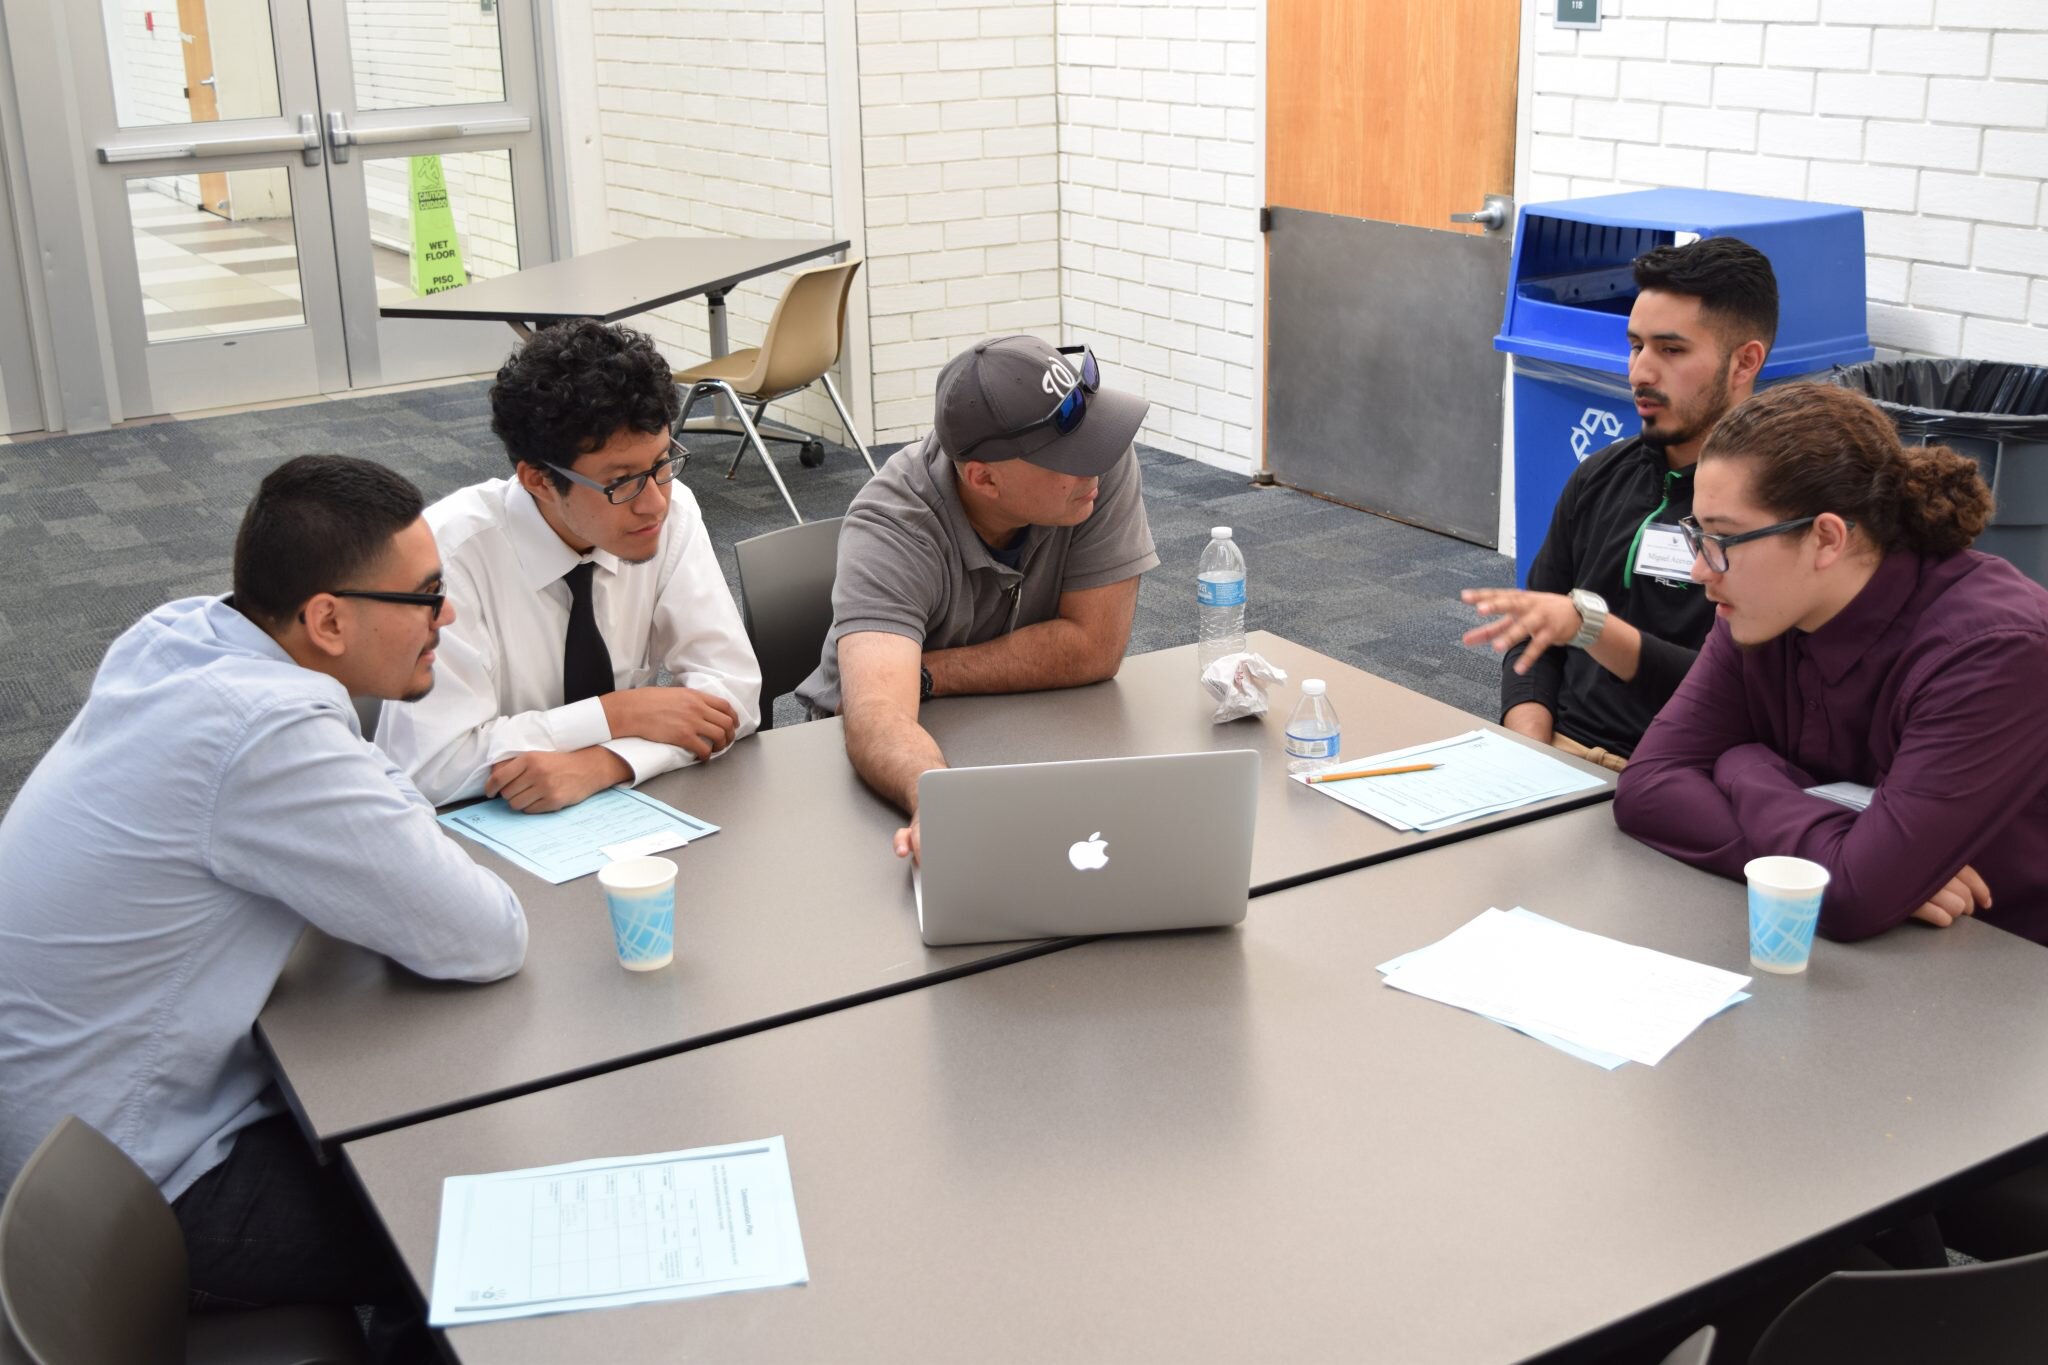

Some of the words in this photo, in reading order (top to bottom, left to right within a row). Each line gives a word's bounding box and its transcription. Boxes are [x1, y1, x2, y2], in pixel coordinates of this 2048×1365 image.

[419, 190, 446, 200] CAUTION
[429, 240, 449, 250] WET
[425, 249, 456, 261] FLOOR
[432, 274, 454, 285] PISO
